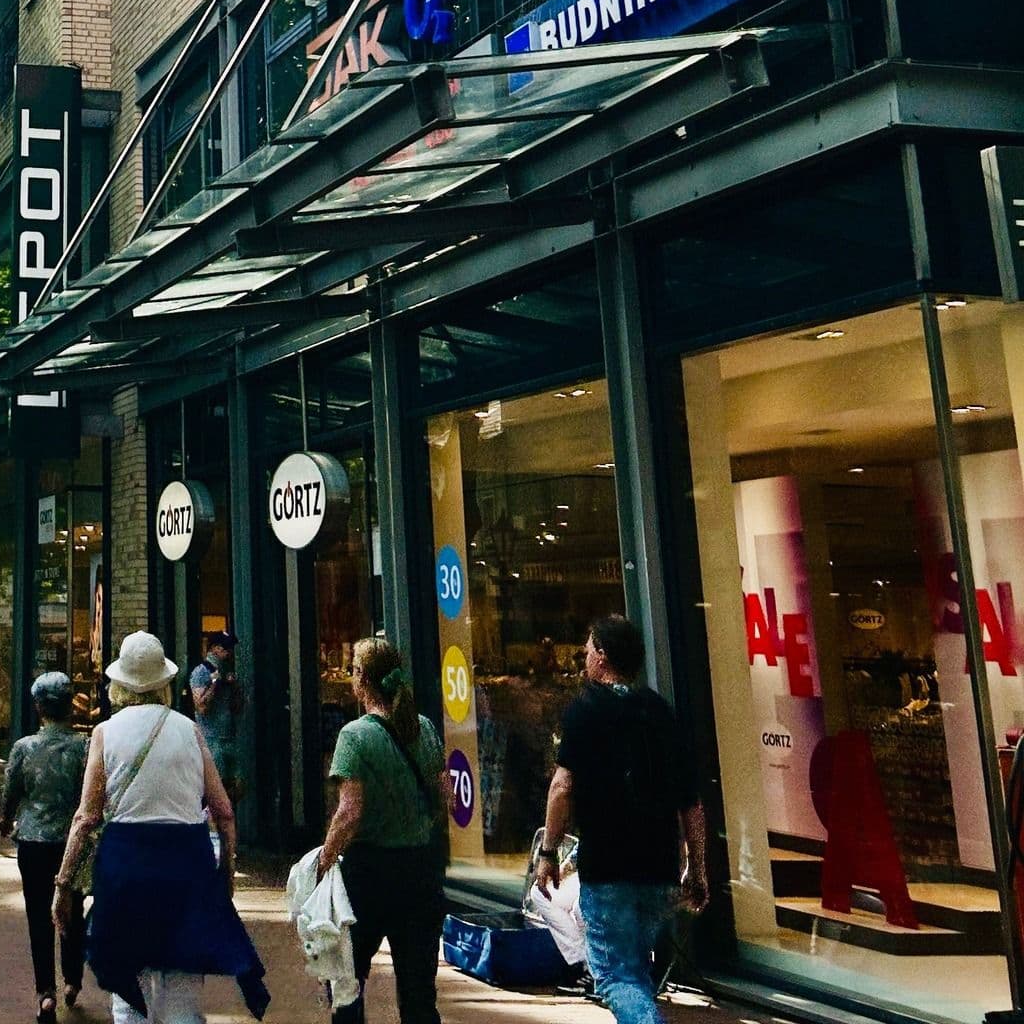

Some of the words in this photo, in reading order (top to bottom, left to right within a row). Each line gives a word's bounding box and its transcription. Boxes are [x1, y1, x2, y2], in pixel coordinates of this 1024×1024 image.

[439, 565, 461, 592] 30
[447, 667, 468, 702] 50
[450, 769, 472, 808] 70
